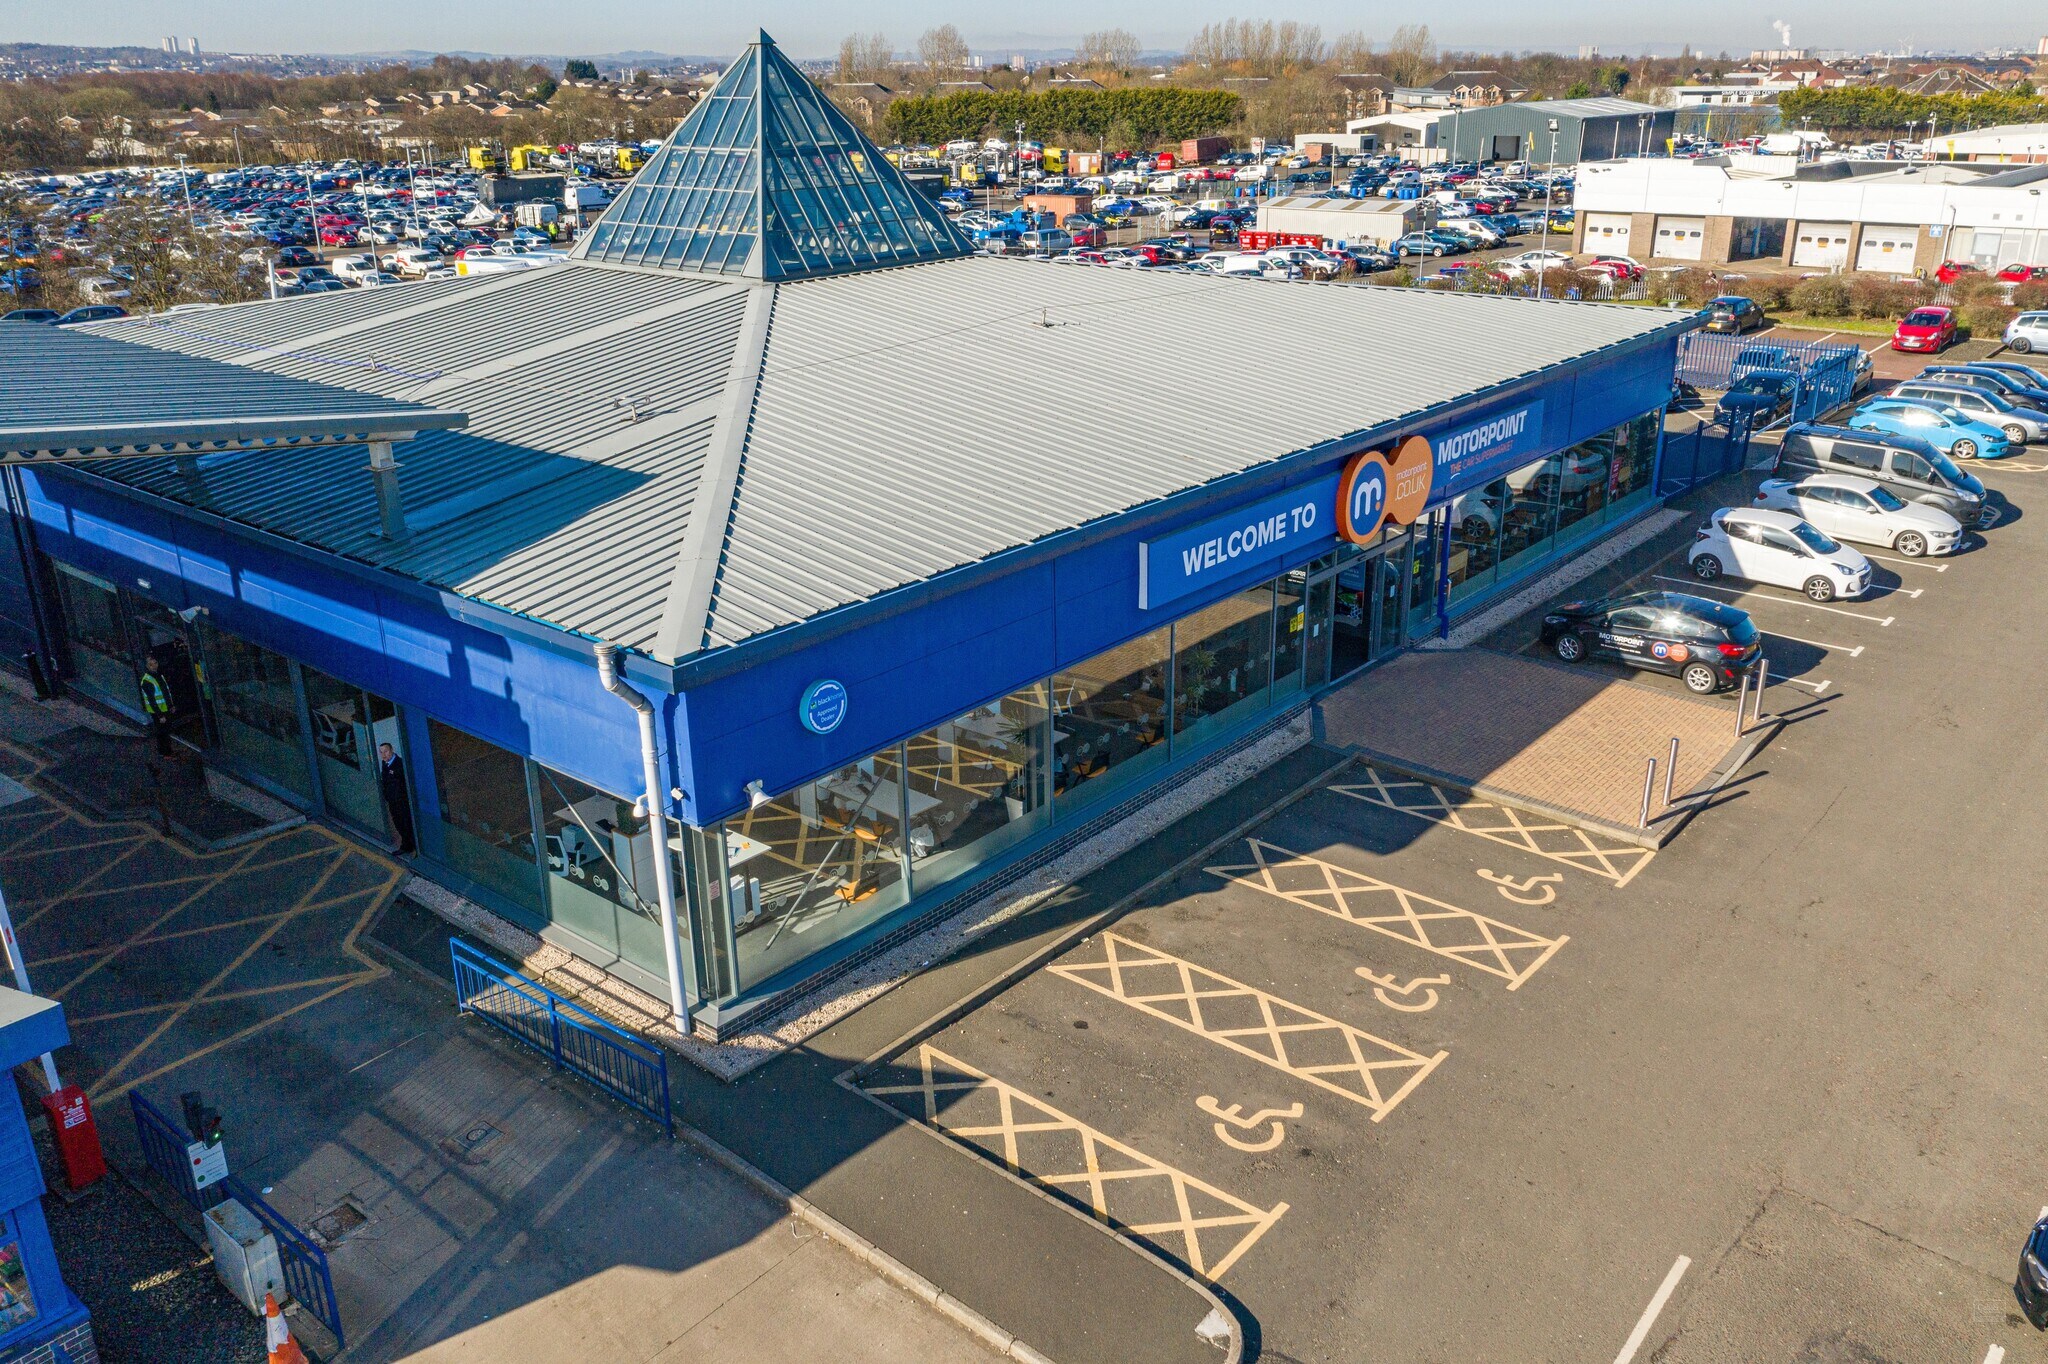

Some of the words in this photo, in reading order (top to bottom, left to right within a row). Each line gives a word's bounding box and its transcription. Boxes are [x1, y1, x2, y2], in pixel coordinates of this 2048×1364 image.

[1438, 410, 1527, 465] MOTORPOINT
[1396, 462, 1428, 480] motorpoint
[1451, 461, 1462, 474] THE
[1463, 456, 1475, 469] CAR
[1183, 512, 1287, 576] WELCOME
[1291, 502, 1316, 533] TO
[1599, 632, 1644, 647] MOTORPOINT
[817, 704, 837, 717] Approved
[821, 714, 835, 723] Dealer
